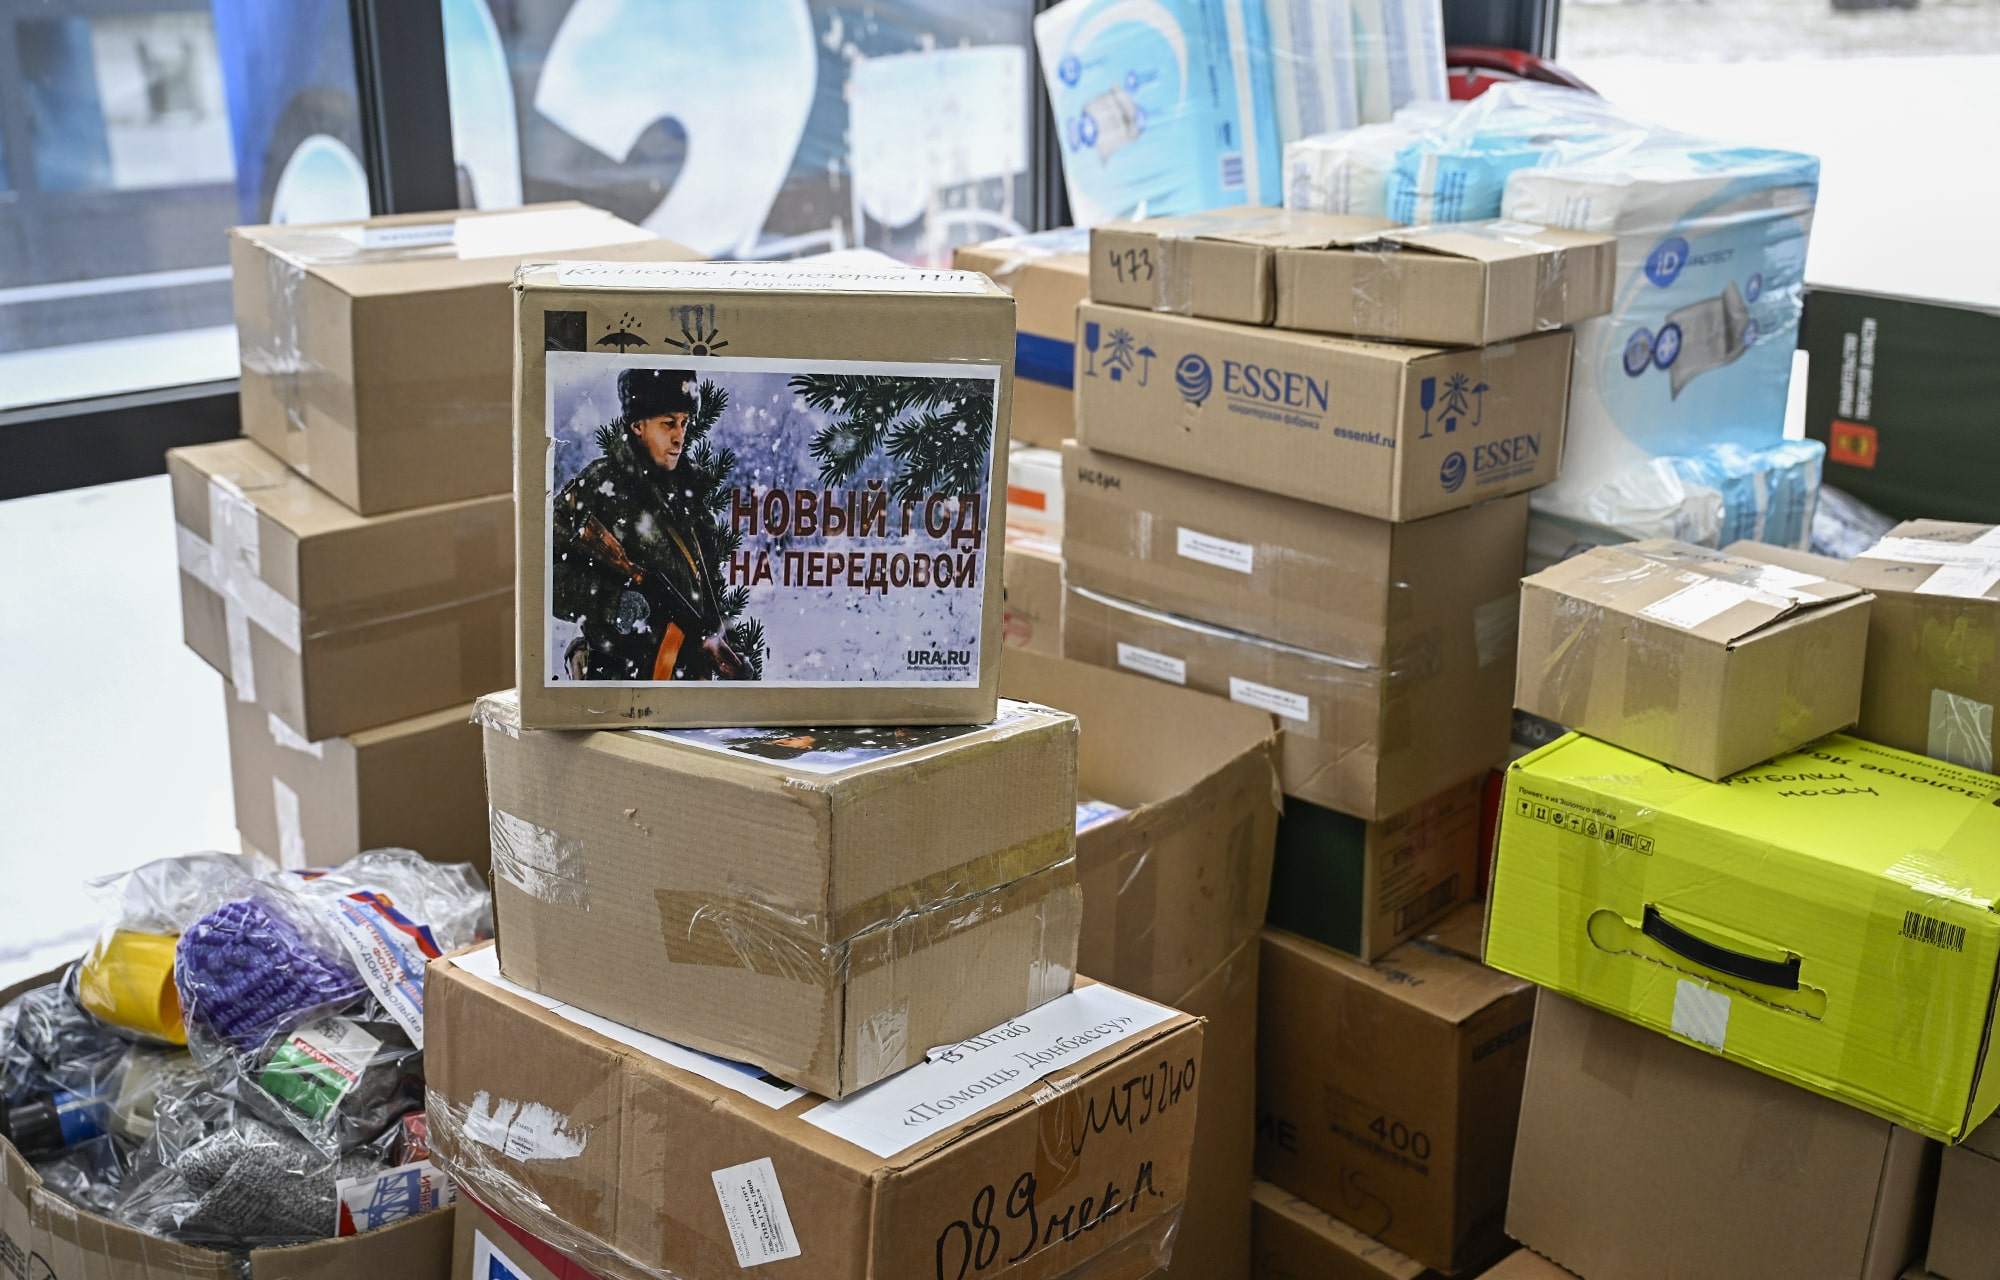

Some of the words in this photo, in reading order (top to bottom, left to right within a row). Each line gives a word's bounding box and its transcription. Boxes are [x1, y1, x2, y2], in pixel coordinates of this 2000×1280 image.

[1222, 359, 1329, 413] ESSEN
[1333, 426, 1397, 449] essenkf.ru
[1473, 431, 1542, 472] ESSEN
[731, 479, 888, 538] НОВЫЙ
[901, 491, 982, 550] ГОД
[729, 550, 774, 587] НА
[783, 545, 977, 596] ПЕРЕДОВОЙ
[907, 650, 970, 666] URA.RU
[1518, 786, 1544, 801] Привет,
[1559, 797, 1591, 813] Золотого
[1859, 762, 1986, 799] Золотое
[372, 946, 395, 984] ФОНД
[362, 951, 423, 1034] ДОБРОВОЛЬЦЕВ
[962, 1020, 1031, 1053] Штаб
[902, 1066, 1021, 1128] «Помощь
[1013, 1015, 1134, 1071] Донбассу»
[1368, 1115, 1431, 1161] 400
